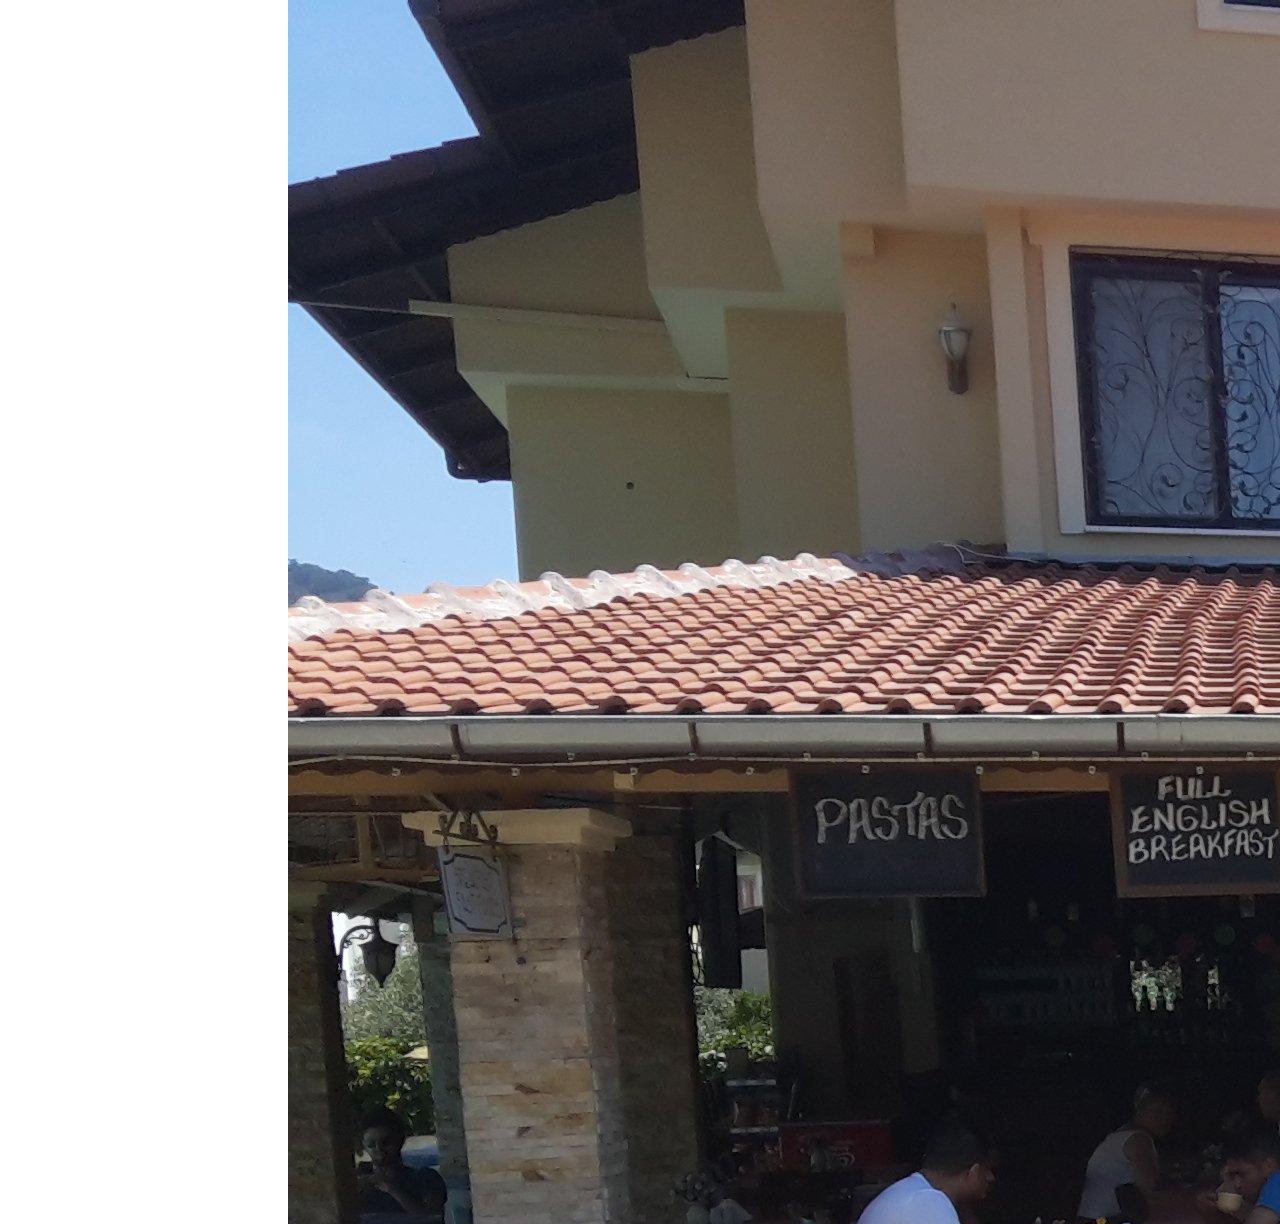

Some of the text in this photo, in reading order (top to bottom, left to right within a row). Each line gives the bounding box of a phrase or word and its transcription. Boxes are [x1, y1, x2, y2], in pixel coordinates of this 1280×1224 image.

[1157, 775, 1232, 801] FULL
[814, 791, 969, 844] PASTAS
[1130, 798, 1271, 834] ENGLISH
[1128, 827, 1280, 864] BREAKFAST
